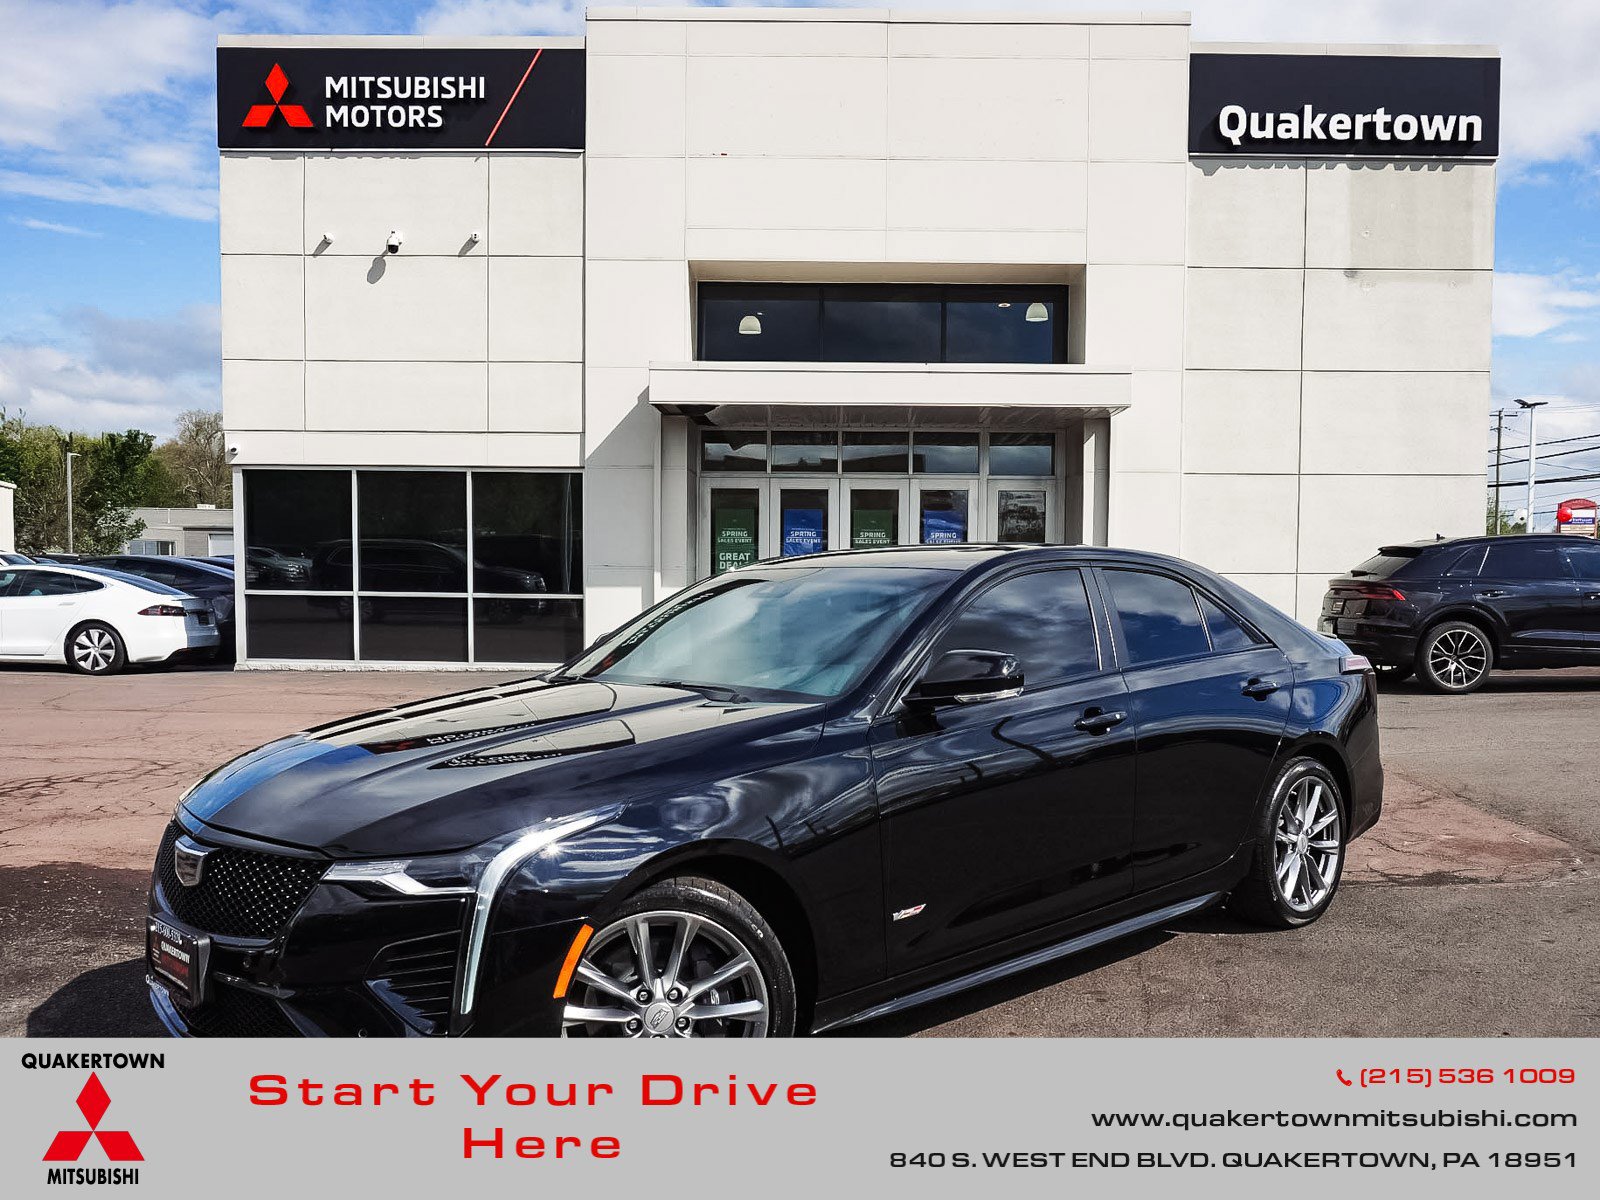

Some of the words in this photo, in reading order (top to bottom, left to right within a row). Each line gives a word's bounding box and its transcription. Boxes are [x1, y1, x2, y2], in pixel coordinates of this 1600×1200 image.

[325, 76, 485, 99] MITSUBISHI
[325, 105, 443, 128] MOTORS
[1219, 104, 1483, 146] Quakertown
[719, 552, 751, 561] GREAT
